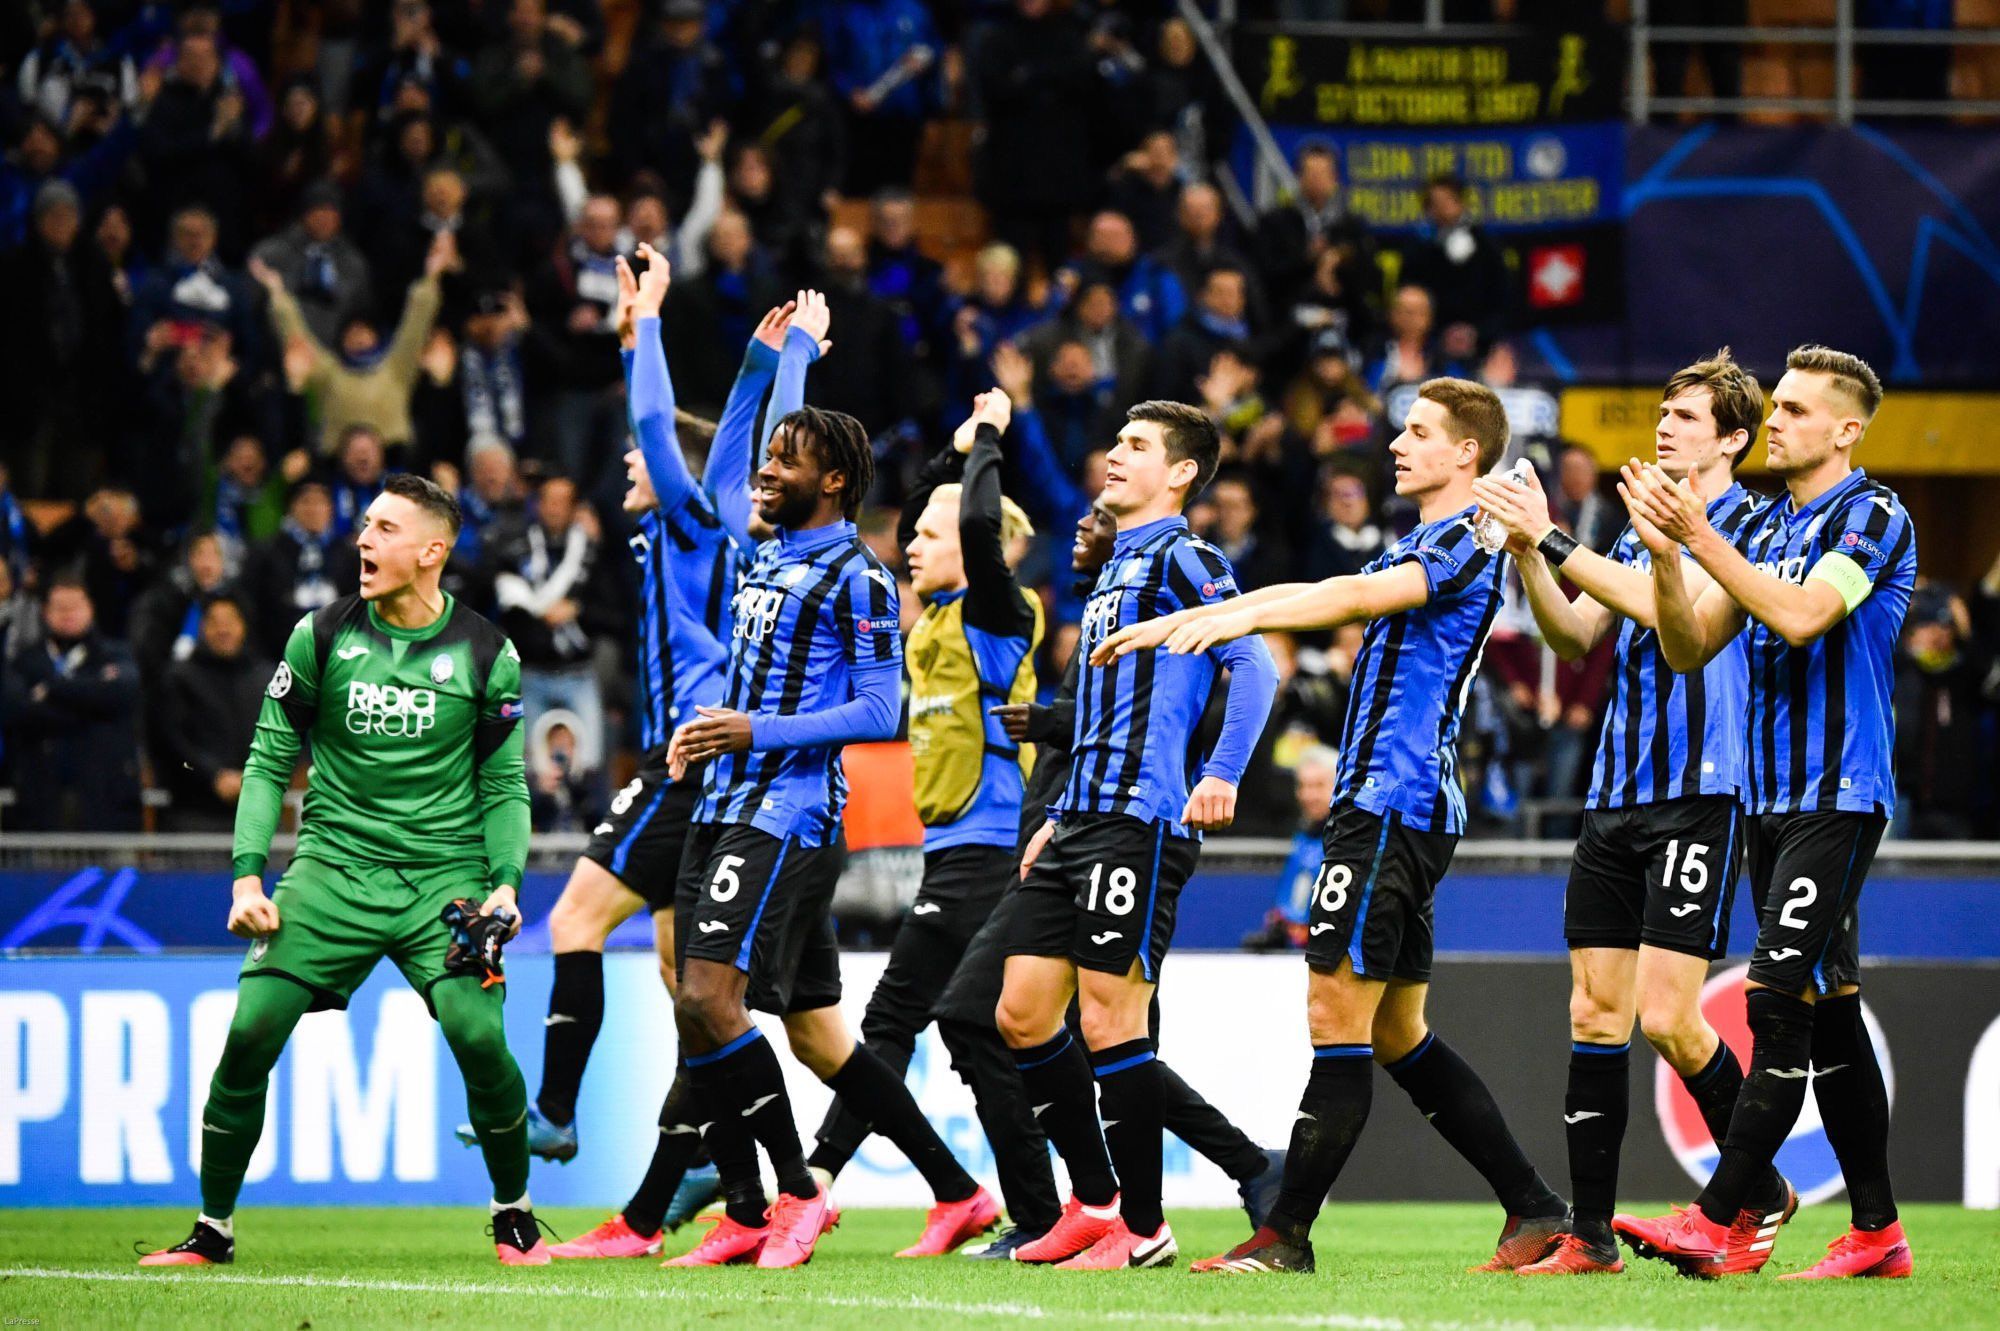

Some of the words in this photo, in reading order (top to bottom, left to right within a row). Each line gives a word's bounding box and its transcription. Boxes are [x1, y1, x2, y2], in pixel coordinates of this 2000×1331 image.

[1372, 47, 1462, 81] PARTIR
[1470, 47, 1508, 80] DU
[1351, 85, 1467, 123] OCTOBRE
[1348, 142, 1415, 180] LOIN
[1463, 141, 1514, 179] TOI
[1427, 547, 1458, 568] RESPECT
[1857, 539, 1886, 561] RESPECT
[870, 620, 898, 629] RESPECT
[347, 680, 436, 715] RADICI
[345, 708, 435, 738] GROUP
[710, 855, 745, 902] 5
[1662, 839, 1709, 893] 15
[1087, 863, 1136, 915] 18
[1779, 877, 1818, 930] 2
